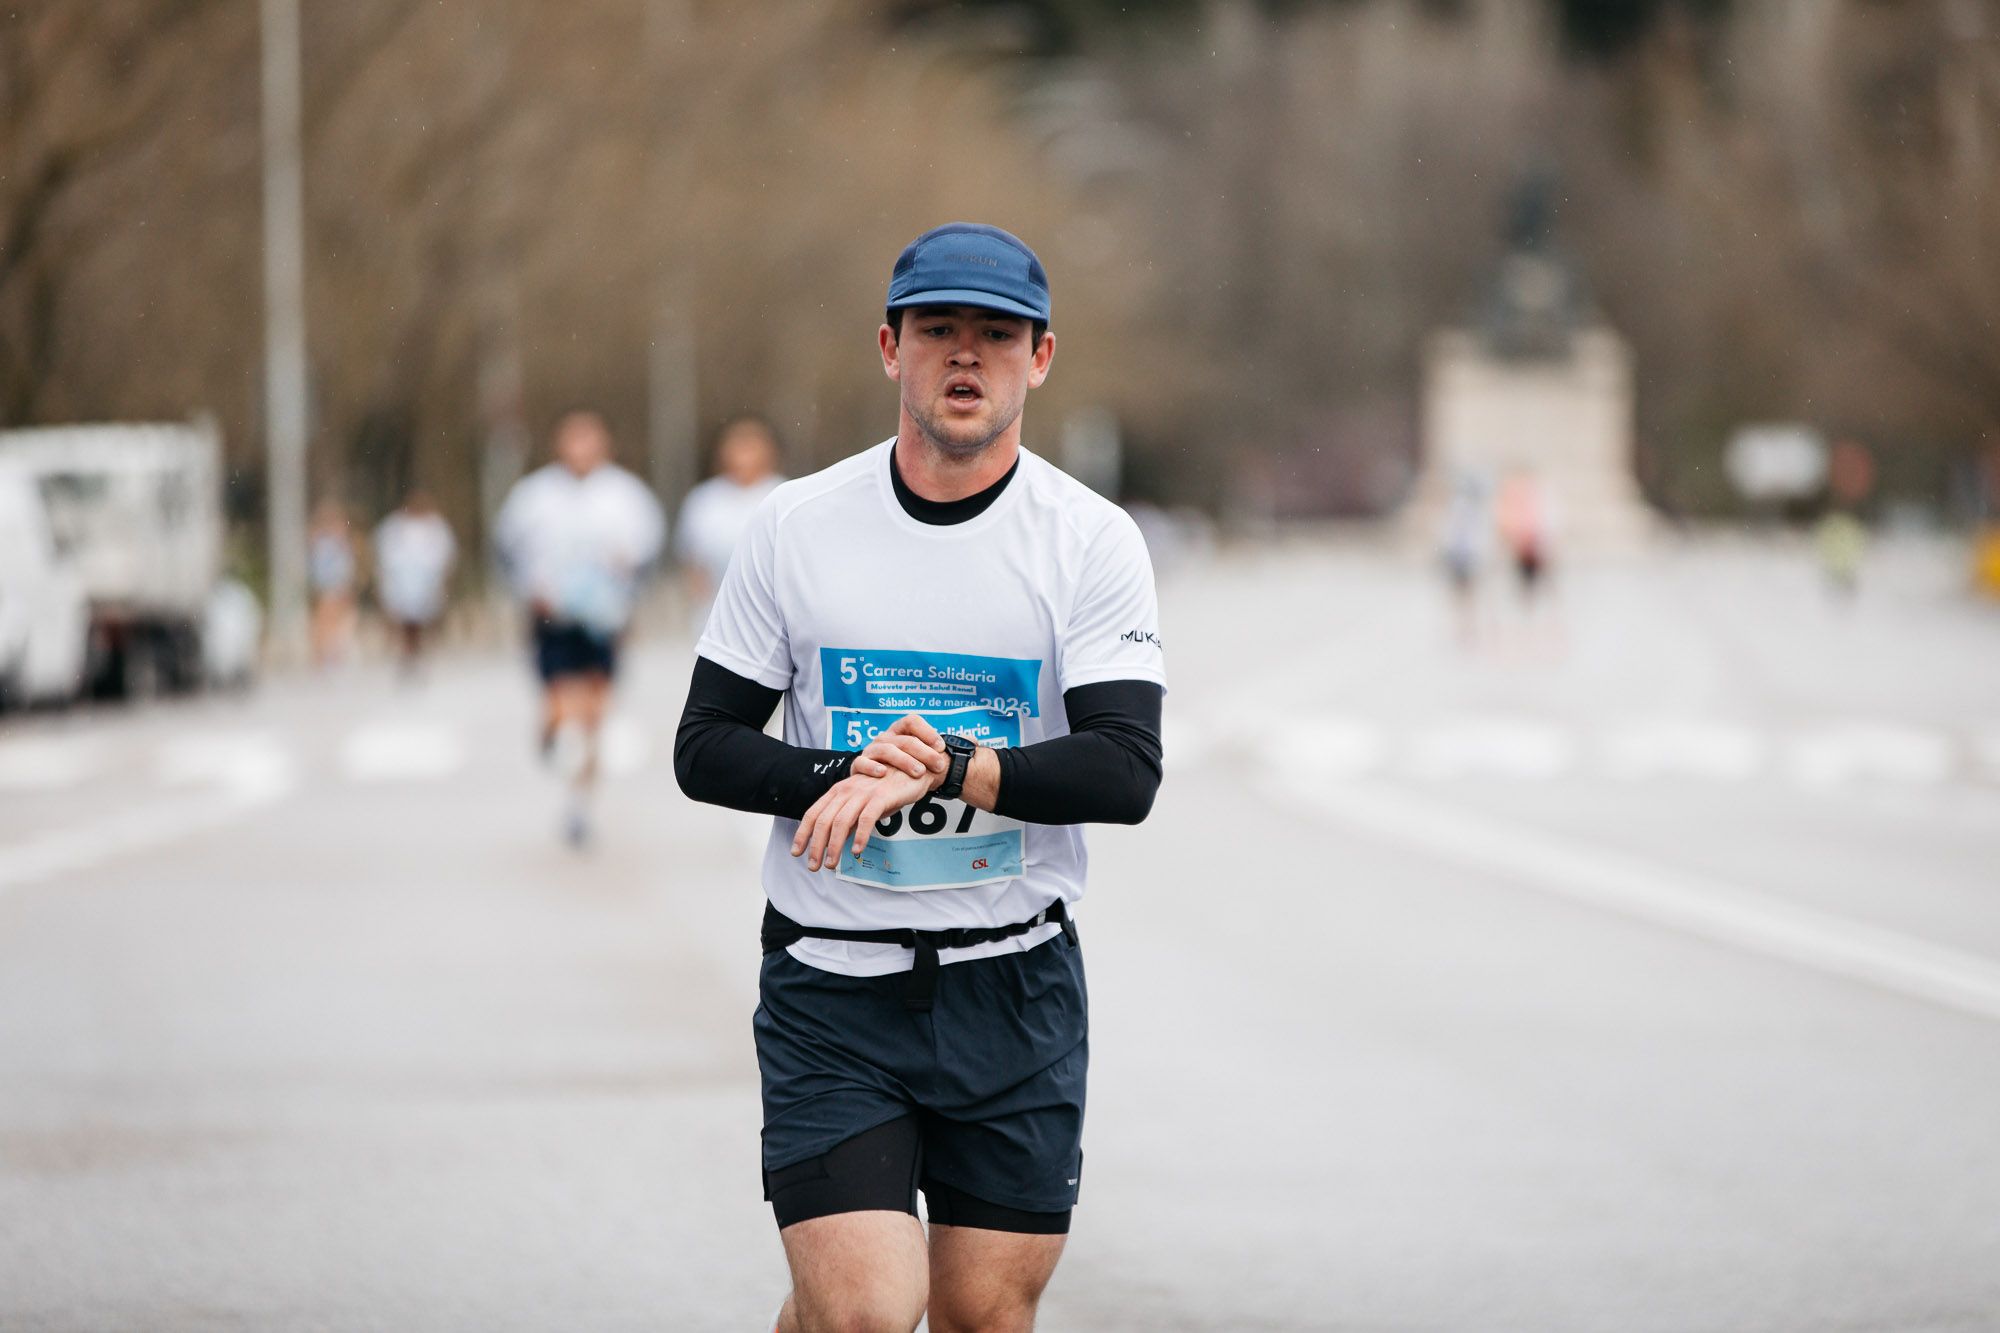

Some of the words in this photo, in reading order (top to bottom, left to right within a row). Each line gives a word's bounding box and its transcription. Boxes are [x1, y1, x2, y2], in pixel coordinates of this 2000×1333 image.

[1121, 630, 1162, 651] MUK
[863, 663, 923, 678] Carrera
[928, 666, 996, 683] Solidaria
[952, 685, 974, 693] Renal
[878, 697, 917, 707] Sábado
[919, 697, 926, 707] 7
[928, 697, 942, 707] de
[944, 699, 977, 707] marzo
[980, 697, 1032, 717] 2026
[940, 723, 990, 737] lidaria
[972, 858, 989, 870] CSL
